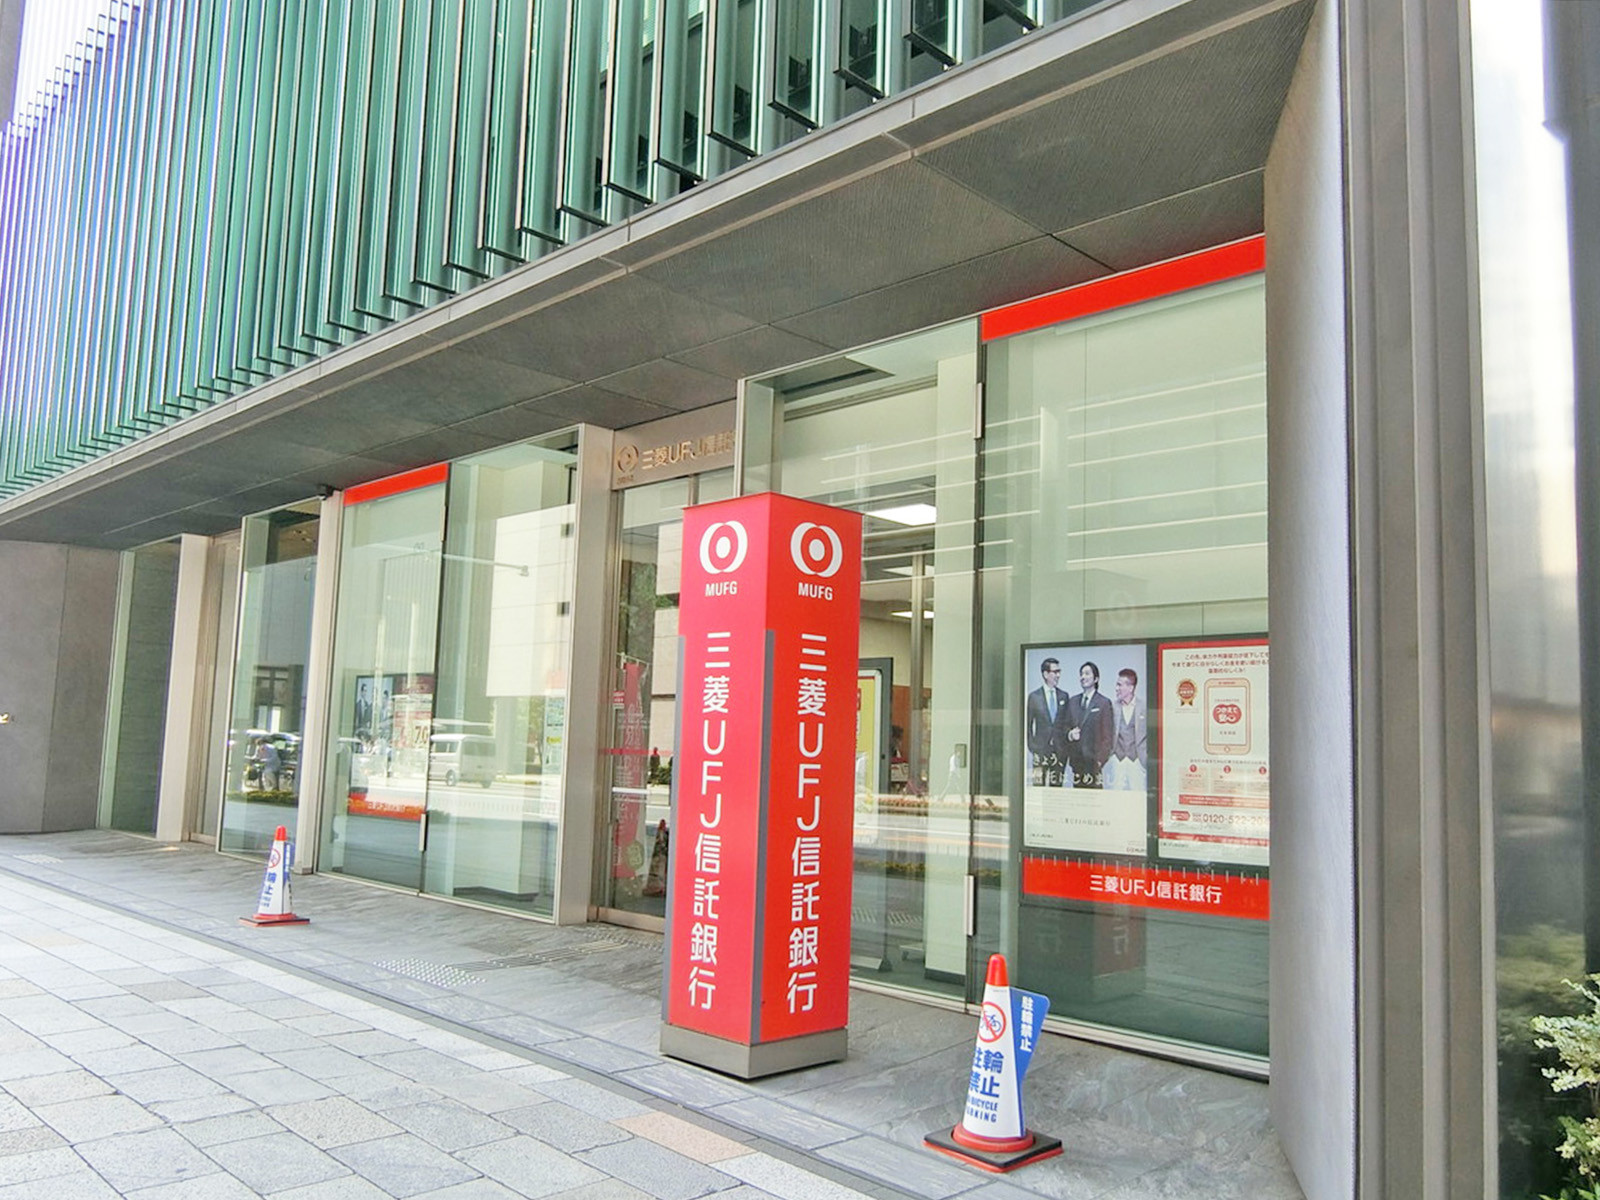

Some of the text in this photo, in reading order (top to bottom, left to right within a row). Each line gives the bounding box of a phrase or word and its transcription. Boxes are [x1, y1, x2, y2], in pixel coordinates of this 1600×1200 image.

[705, 581, 738, 597] MUFG
[798, 581, 834, 601] MUFG
[688, 631, 731, 1010] 三菱UFJ信託銀行
[787, 633, 827, 1014] 三菱UFJ信託銀行
[1090, 874, 1223, 904] 三菱UFJ信託銀行
